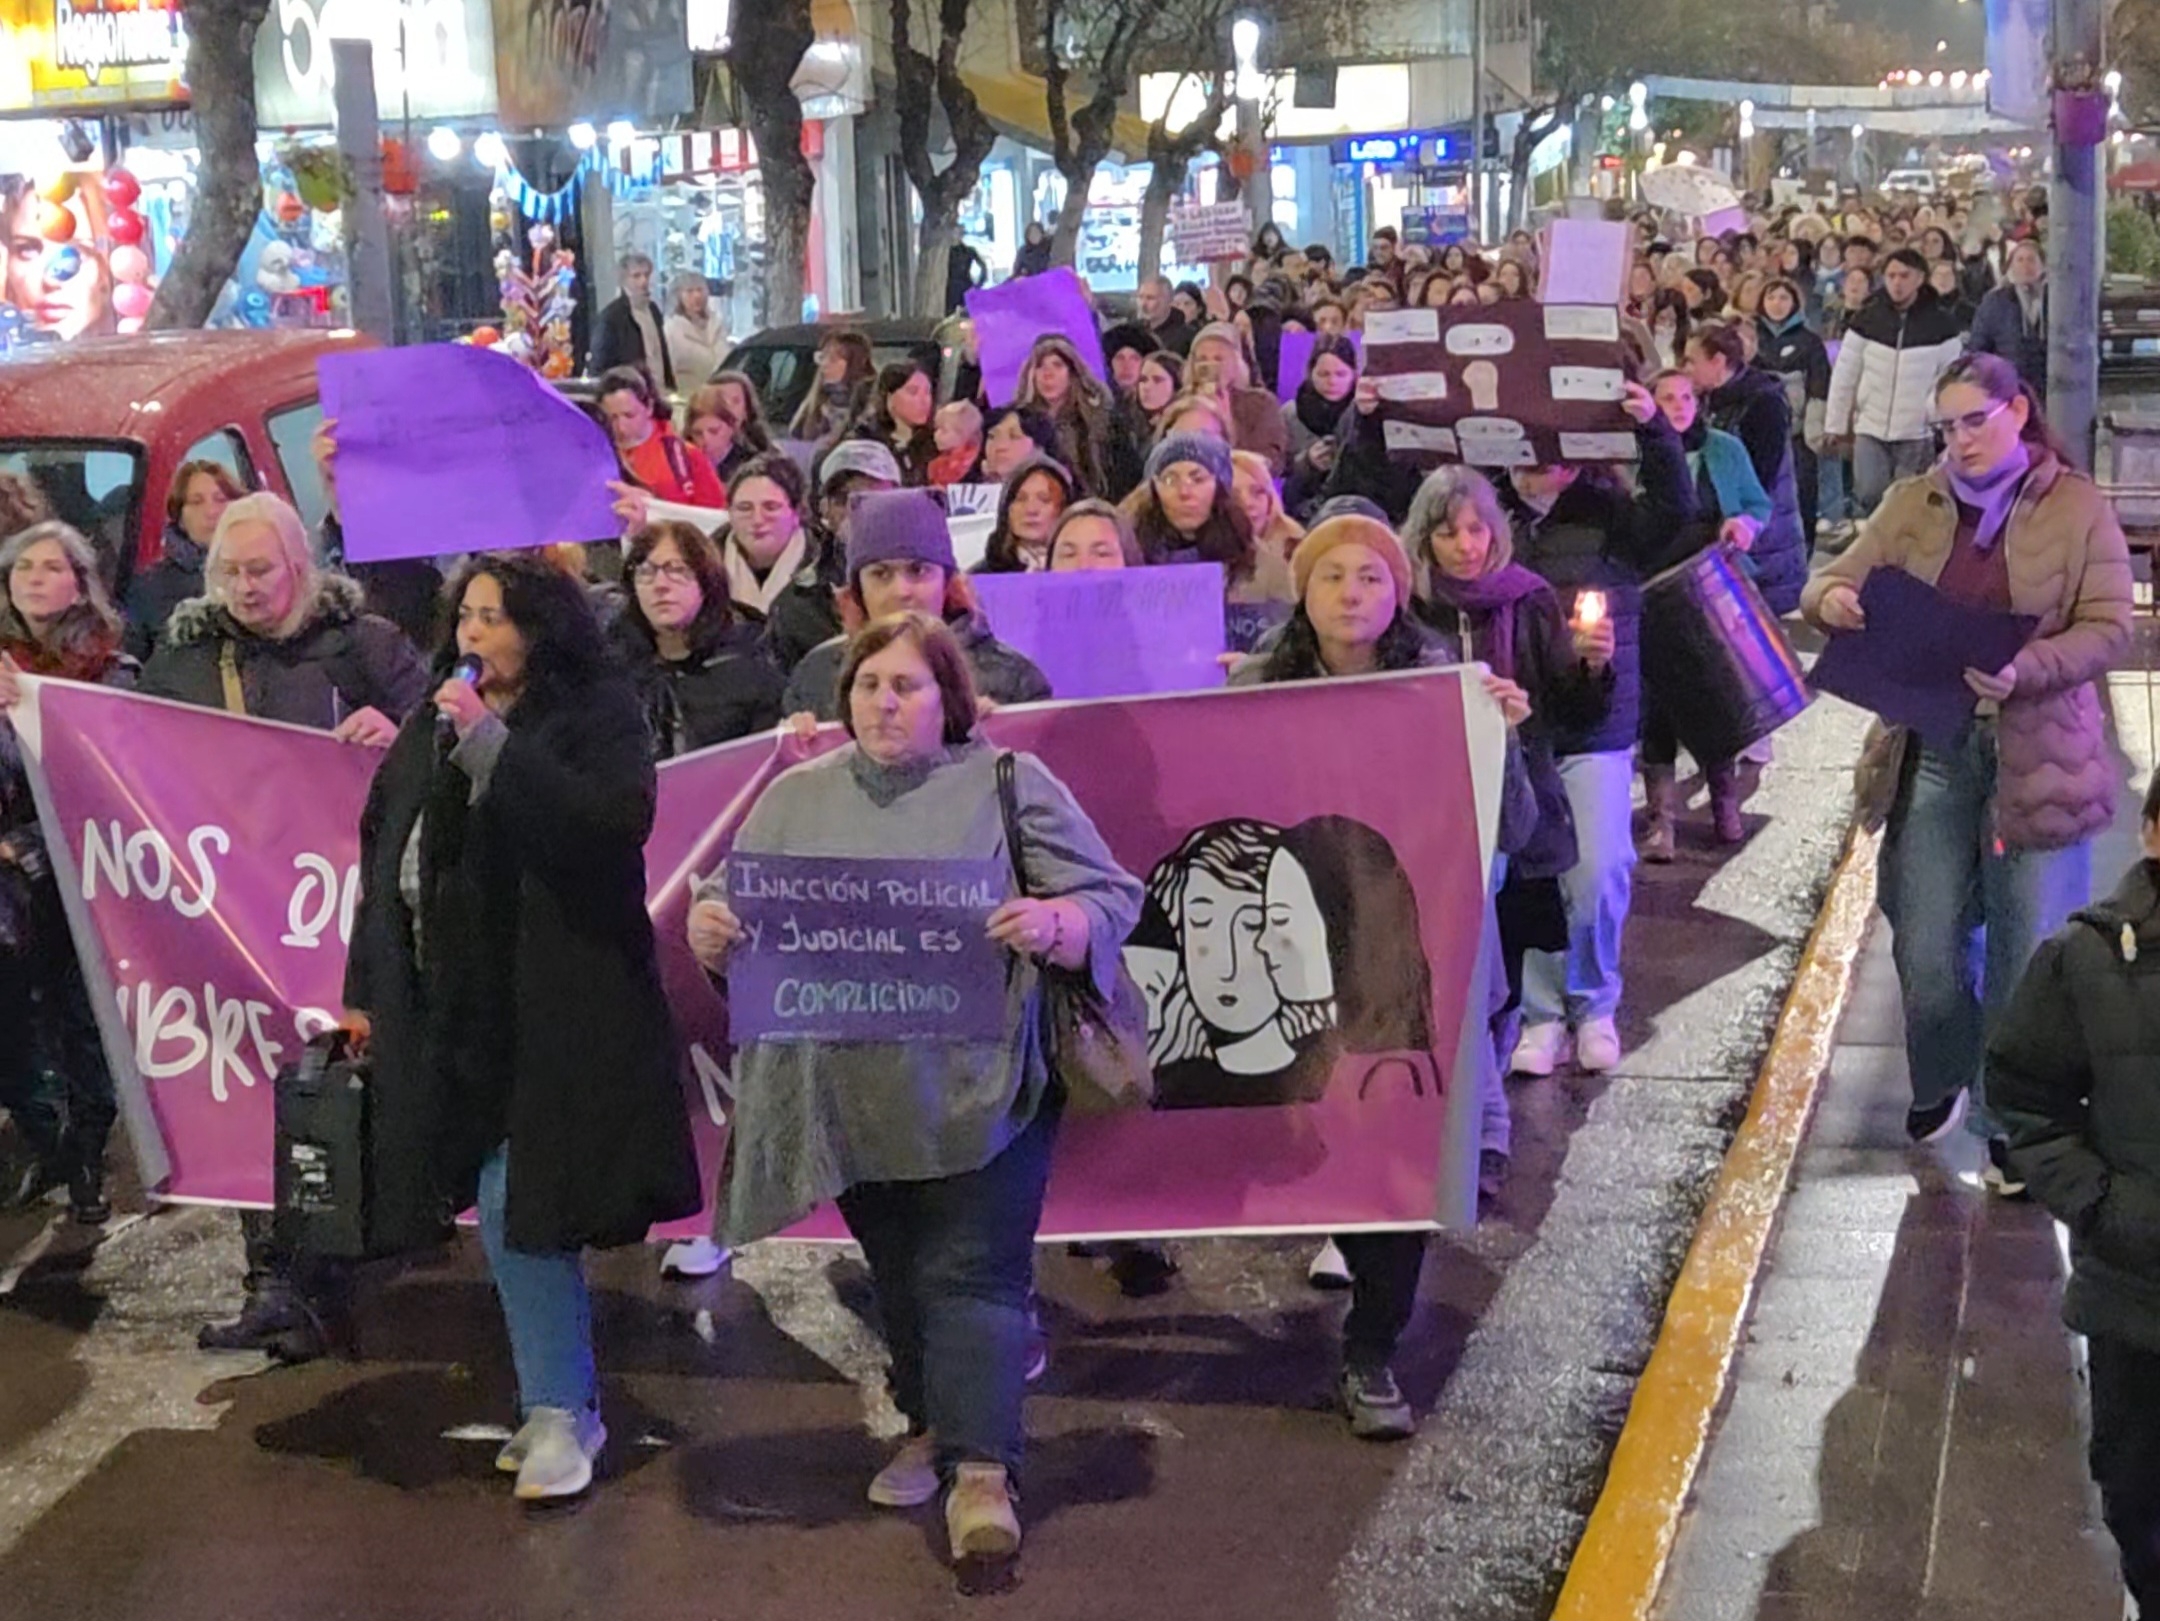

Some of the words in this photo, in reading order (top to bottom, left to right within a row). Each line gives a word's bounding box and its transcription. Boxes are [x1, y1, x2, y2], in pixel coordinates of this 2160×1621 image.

[82, 818, 230, 918] NOS
[734, 861, 869, 902] INACCIÓN
[878, 880, 1000, 907] POLICIAL
[745, 920, 763, 951] Y
[778, 913, 906, 954] JUDICIAL
[920, 929, 963, 952] ES
[774, 978, 961, 1018] COMPLICIDAD
